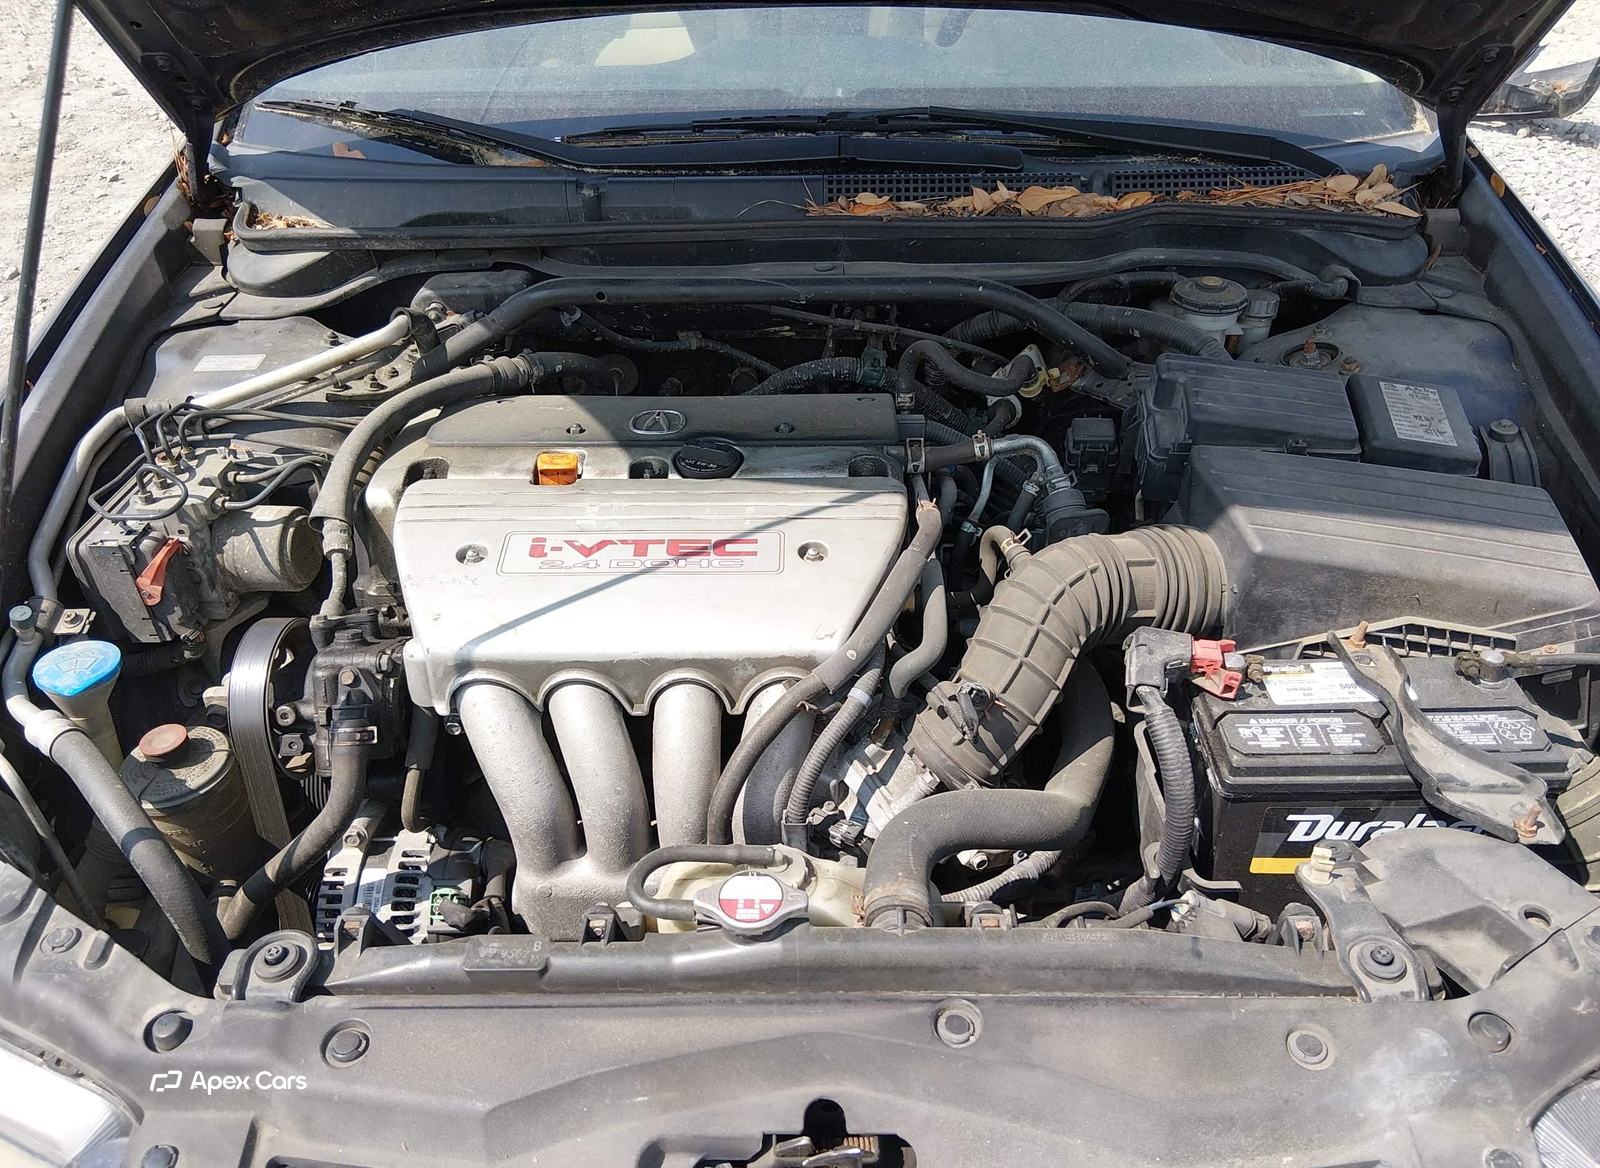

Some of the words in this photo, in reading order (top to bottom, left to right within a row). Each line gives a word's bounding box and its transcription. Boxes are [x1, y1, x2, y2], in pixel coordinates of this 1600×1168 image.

[528, 536, 759, 558] i-VTEC
[538, 558, 600, 570] 2.4
[609, 558, 744, 569] DOHC
